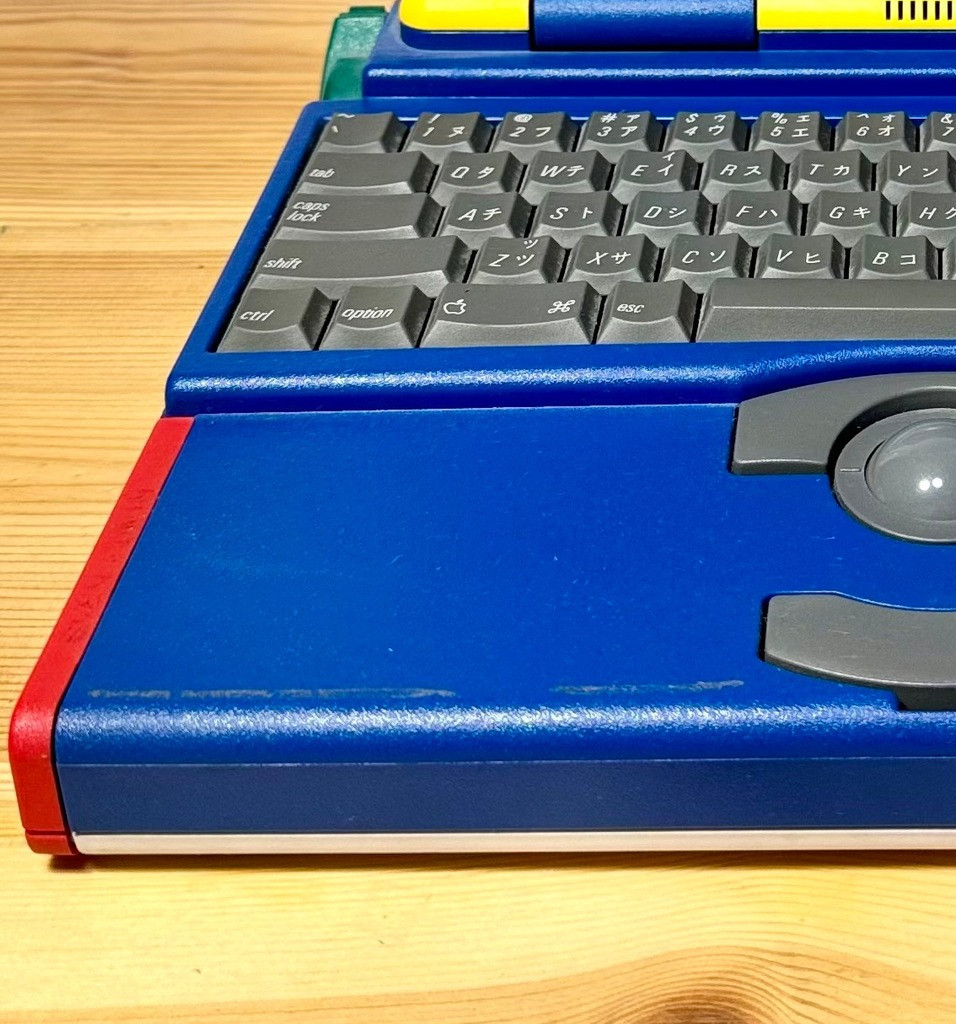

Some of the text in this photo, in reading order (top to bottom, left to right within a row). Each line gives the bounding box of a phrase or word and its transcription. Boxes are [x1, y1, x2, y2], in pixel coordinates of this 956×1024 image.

[509, 126, 526, 138] 2
[596, 126, 613, 137] 3
[684, 126, 699, 136] 4
[770, 126, 784, 137] 5
[856, 126, 870, 137] 6
[309, 168, 335, 178] tab
[540, 164, 567, 178] W
[630, 164, 649, 177] E
[719, 163, 738, 176] R
[809, 163, 824, 175] T
[897, 164, 912, 177] Y
[291, 200, 331, 213] caps
[549, 206, 569, 220] S
[643, 205, 663, 219] D
[735, 205, 753, 218] F
[829, 206, 846, 219] G
[919, 206, 937, 220] H
[286, 210, 322, 222] lock
[457, 208, 478, 222] A
[488, 253, 510, 267] Z
[586, 251, 609, 265] X
[681, 250, 700, 264] C
[776, 249, 793, 263] V
[872, 251, 889, 265] B
[263, 257, 303, 269] shift
[341, 306, 394, 321] option
[616, 303, 645, 313] esc
[240, 309, 275, 322] ctrl
